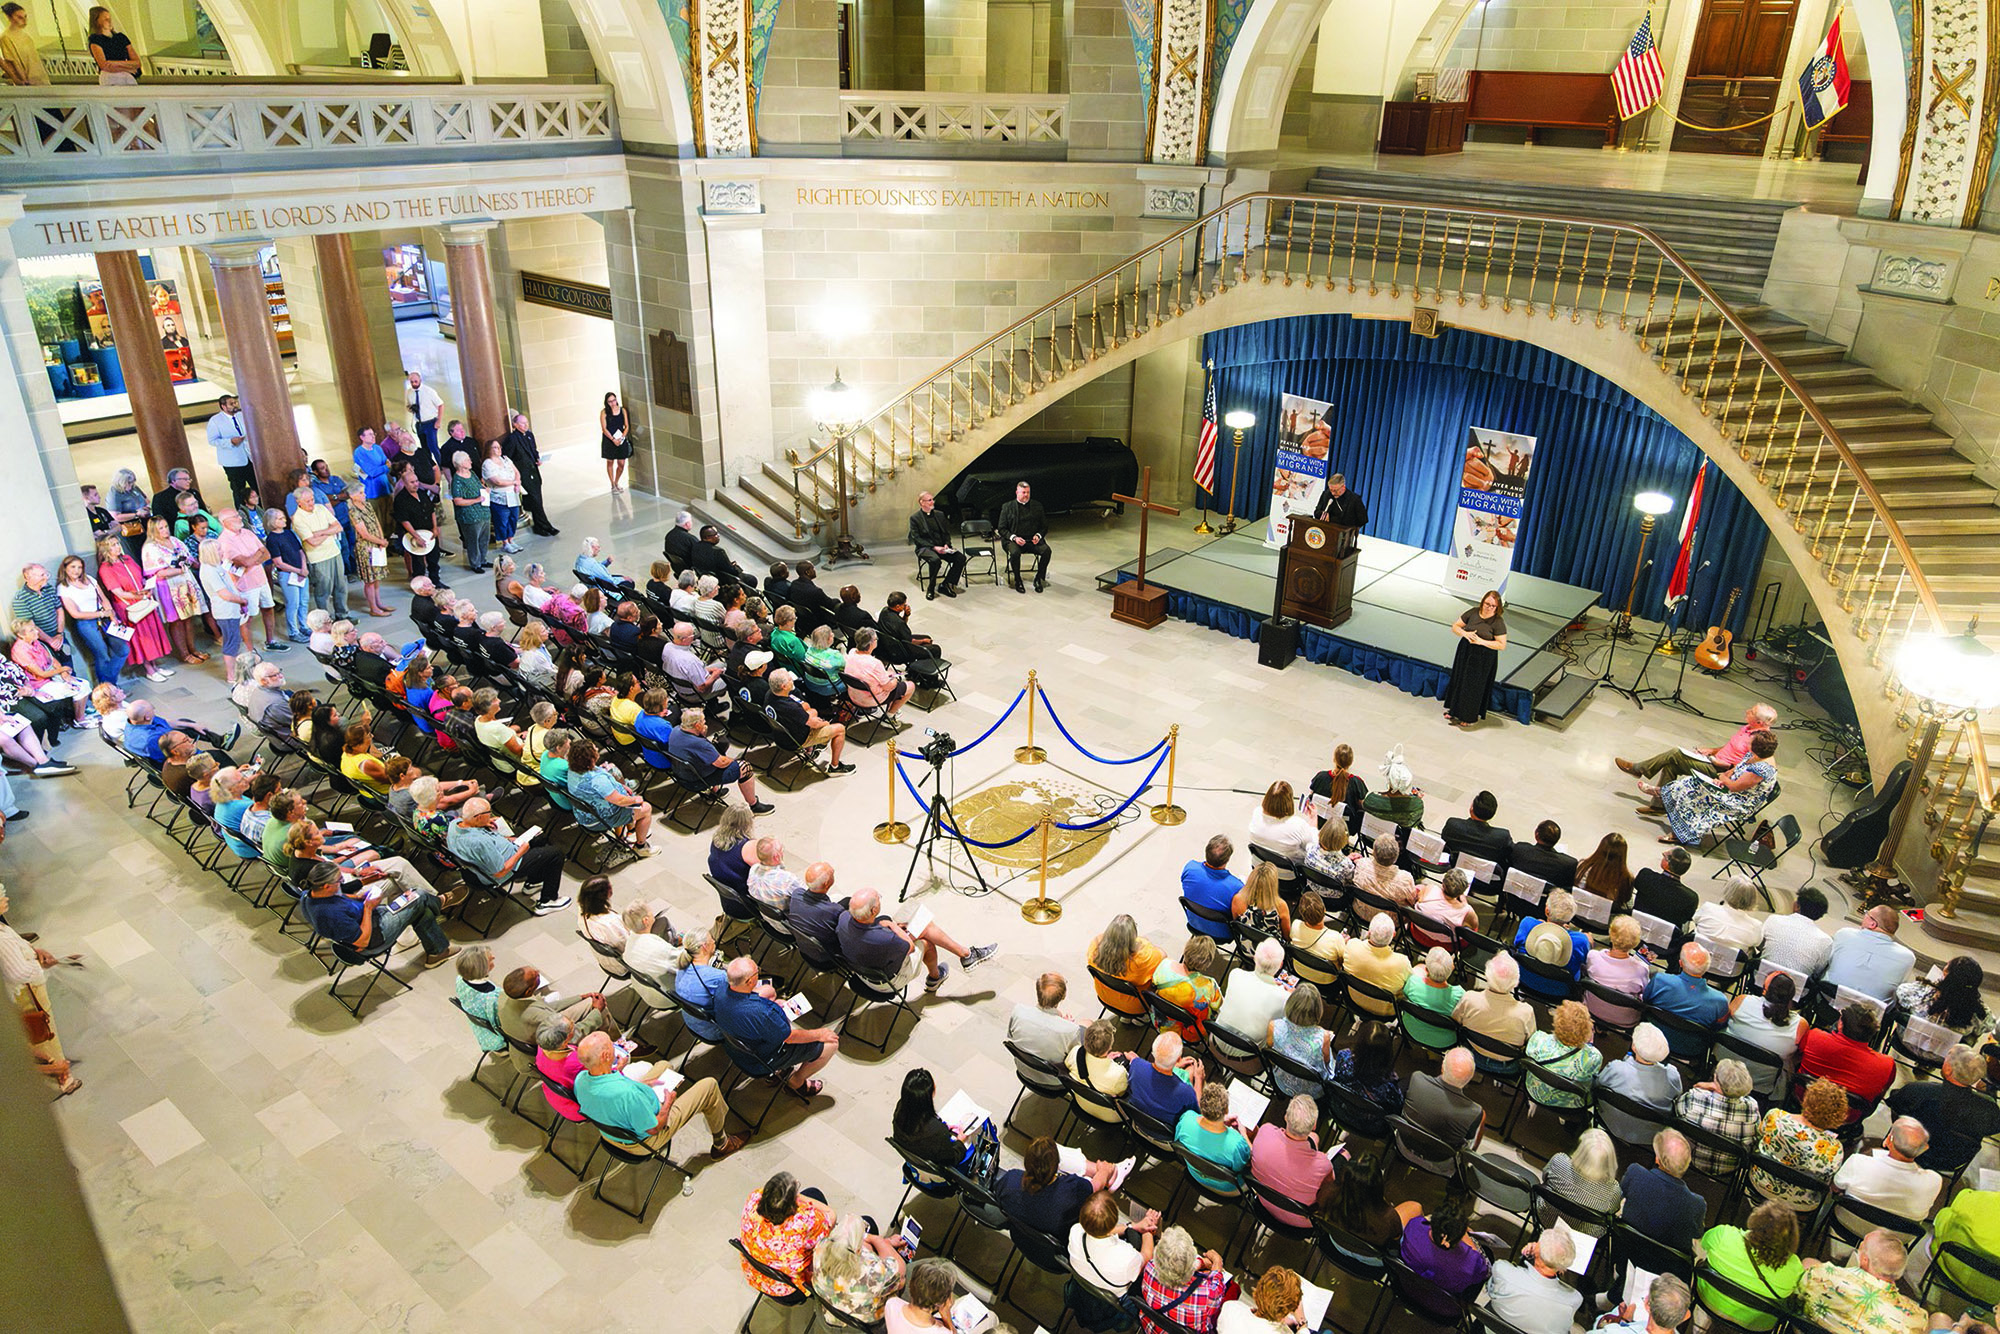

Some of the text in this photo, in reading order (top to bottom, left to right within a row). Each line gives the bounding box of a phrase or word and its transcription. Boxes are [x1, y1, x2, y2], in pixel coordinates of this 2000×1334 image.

[797, 188, 1110, 209] RIGHTEOUSNESS EXALTETH A NATION
[35, 186, 596, 244] THE EARTH IS THE LORD'S AND THE FULLNESS THEREOF
[524, 280, 548, 297] HALL
[547, 286, 560, 299] OF
[1279, 459, 1324, 475] MIGRANTS
[1280, 452, 1325, 468] STANDING WITH
[1463, 490, 1520, 507] STANDING WITH
[1496, 489, 1523, 498] WITNESS
[1461, 498, 1518, 515] MIGRANTS
